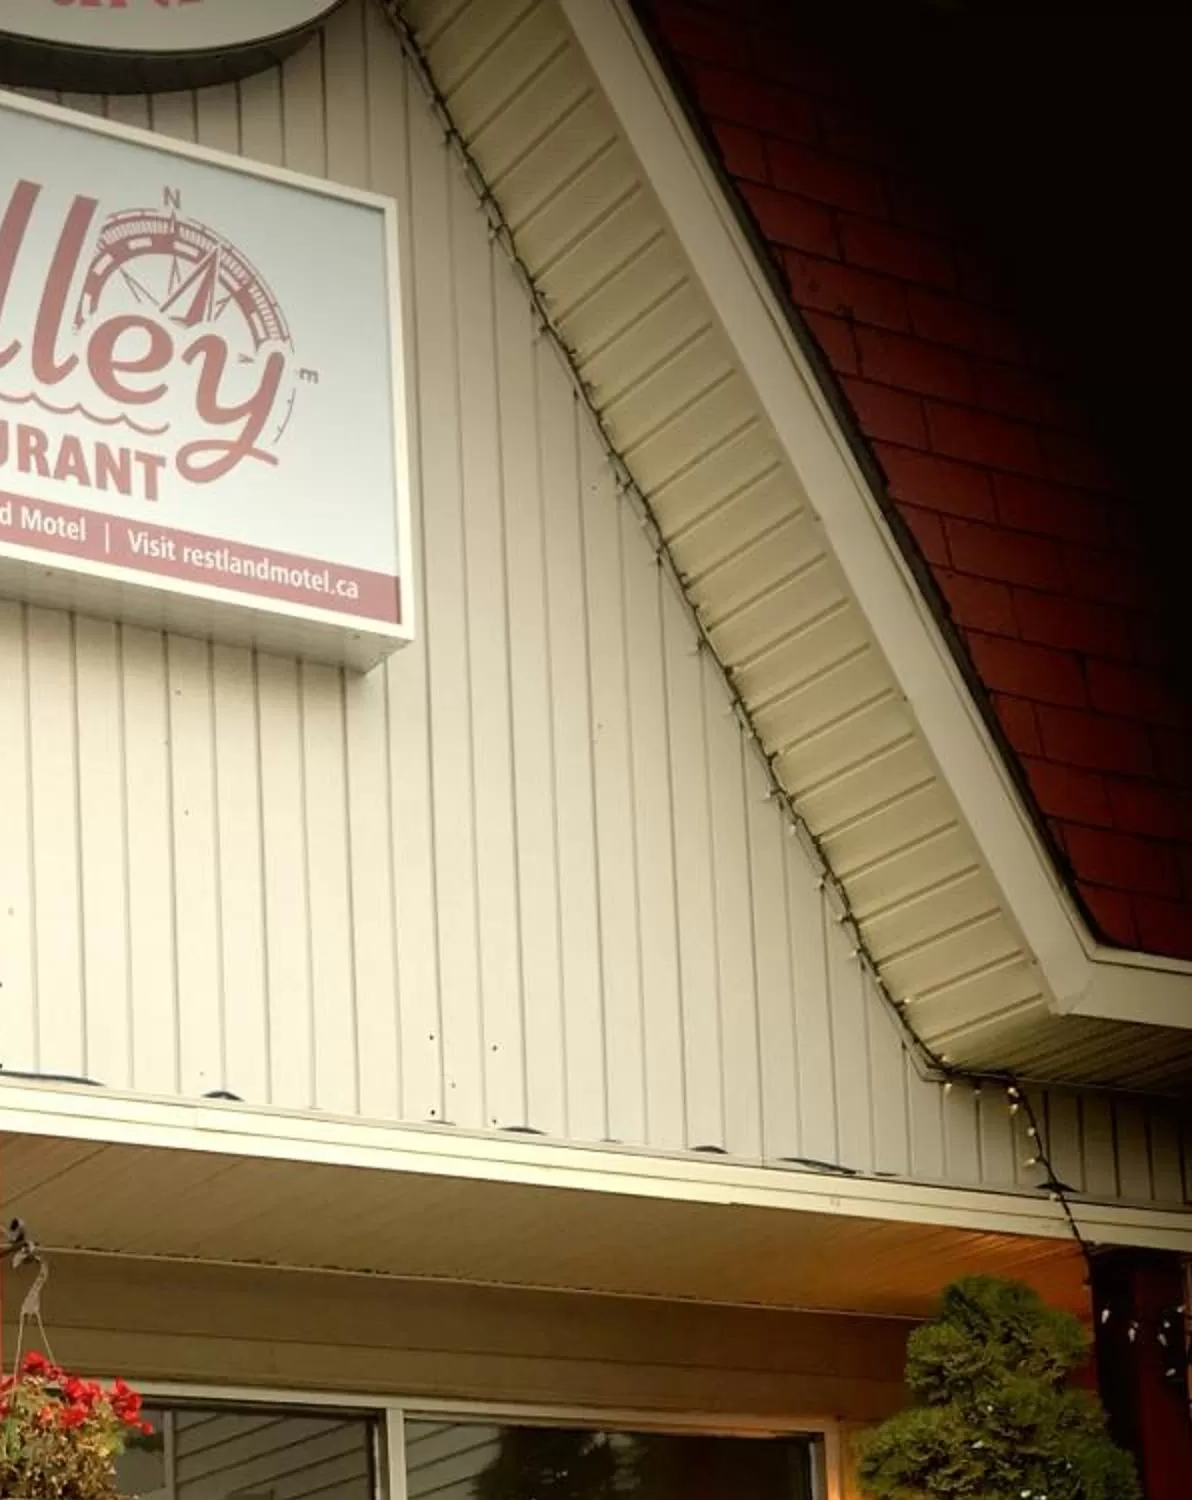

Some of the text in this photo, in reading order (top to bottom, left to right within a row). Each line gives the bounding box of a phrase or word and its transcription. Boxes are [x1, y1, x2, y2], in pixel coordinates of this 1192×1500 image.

[163, 186, 181, 208] N
[20, 506, 87, 541] Motel
[127, 529, 177, 561] Visit
[183, 549, 359, 599] restlandmotel.ca
